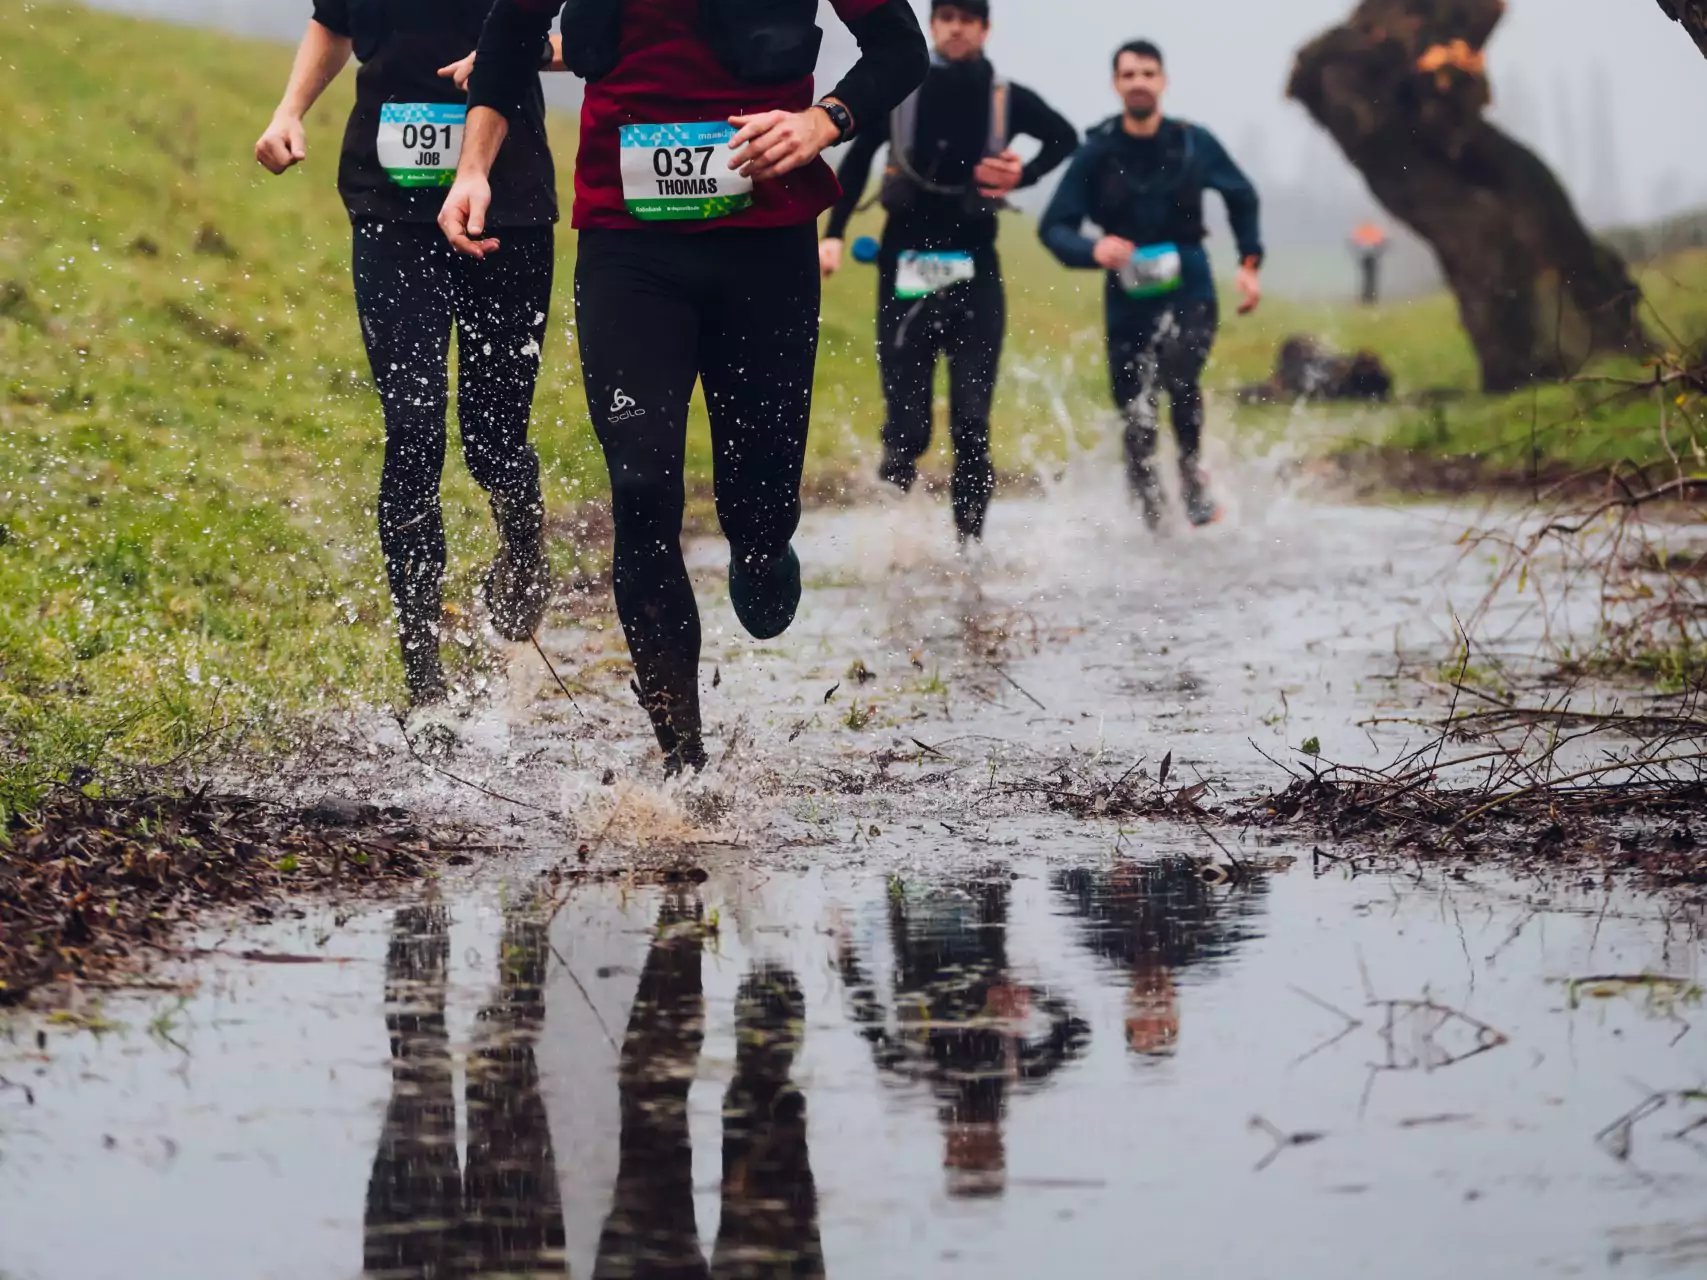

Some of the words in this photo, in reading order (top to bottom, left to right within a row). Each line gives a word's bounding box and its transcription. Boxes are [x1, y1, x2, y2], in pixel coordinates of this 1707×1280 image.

[403, 124, 451, 149] 091
[415, 151, 440, 166] JOB
[653, 146, 715, 177] 037
[656, 177, 718, 195] THOMAS
